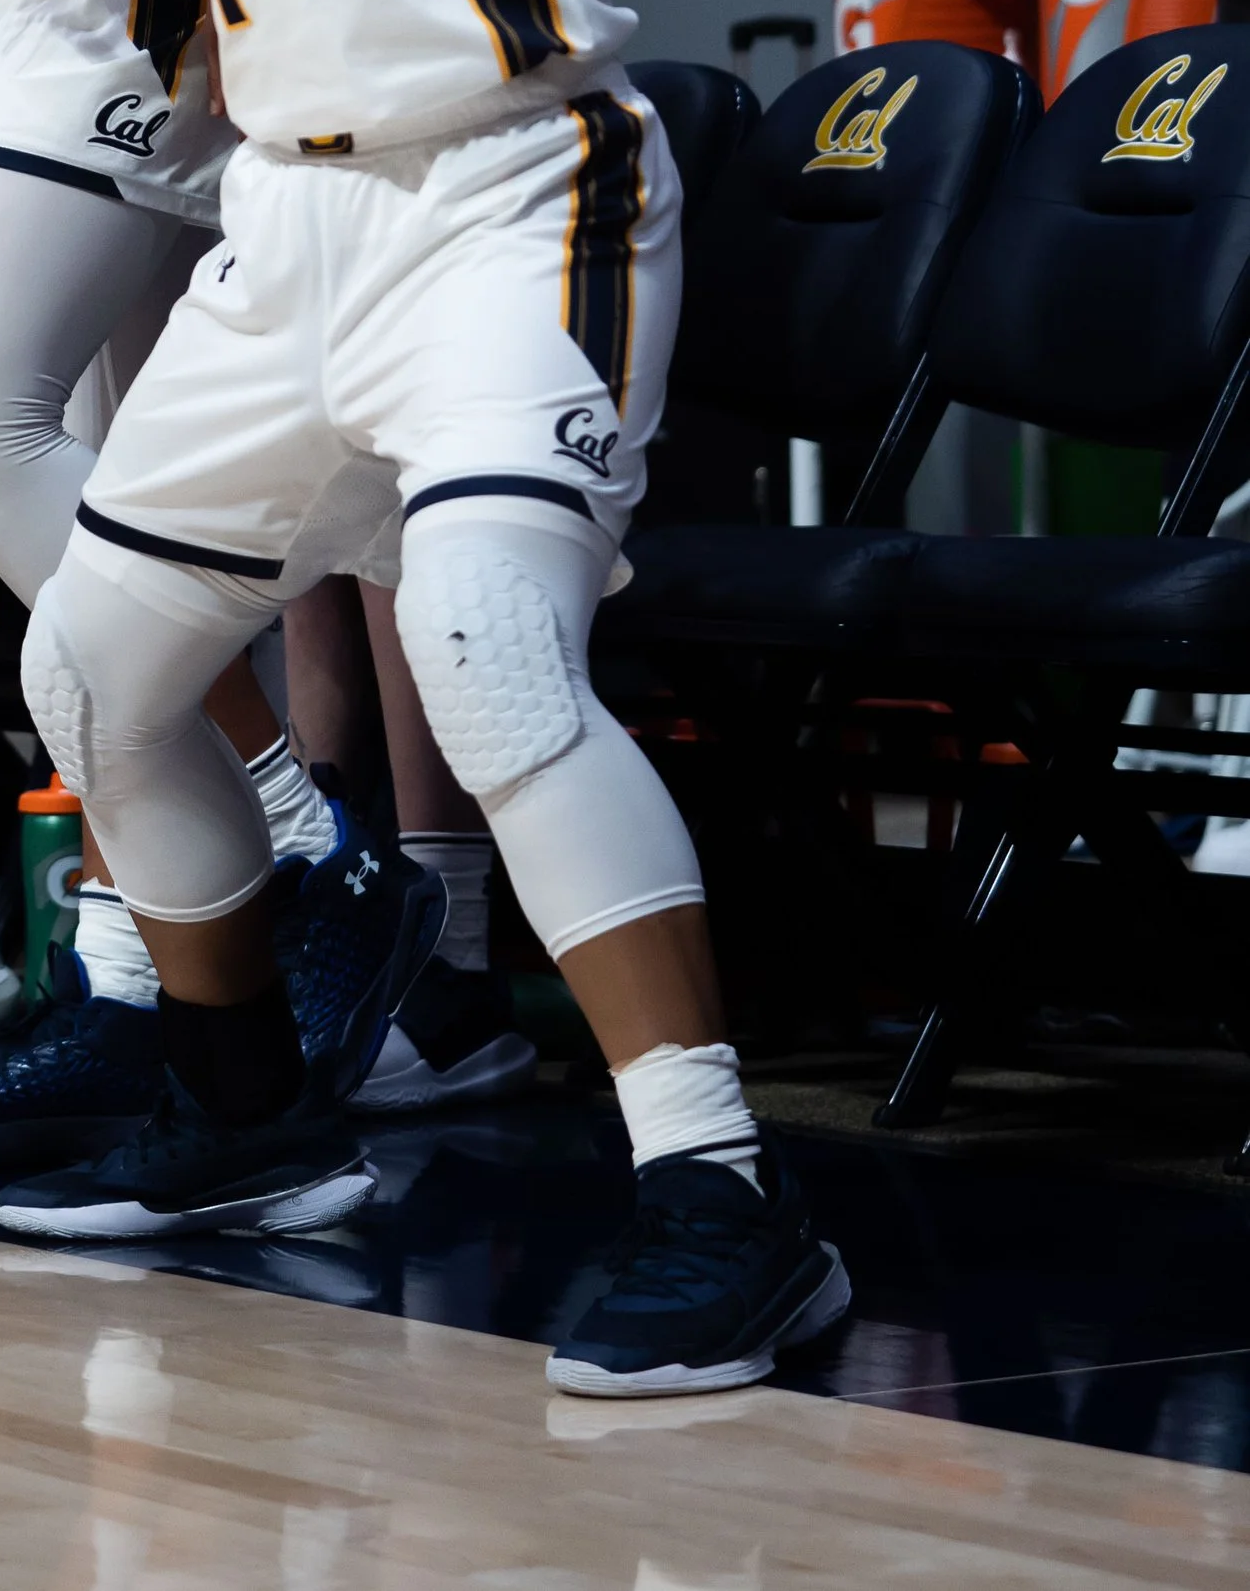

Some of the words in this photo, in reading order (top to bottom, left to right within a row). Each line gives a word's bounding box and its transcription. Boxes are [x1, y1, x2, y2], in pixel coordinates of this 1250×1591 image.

[86, 93, 171, 157] Cal
[800, 66, 919, 174] Cal
[1100, 53, 1229, 163] Cal
[552, 407, 619, 479] Cal
